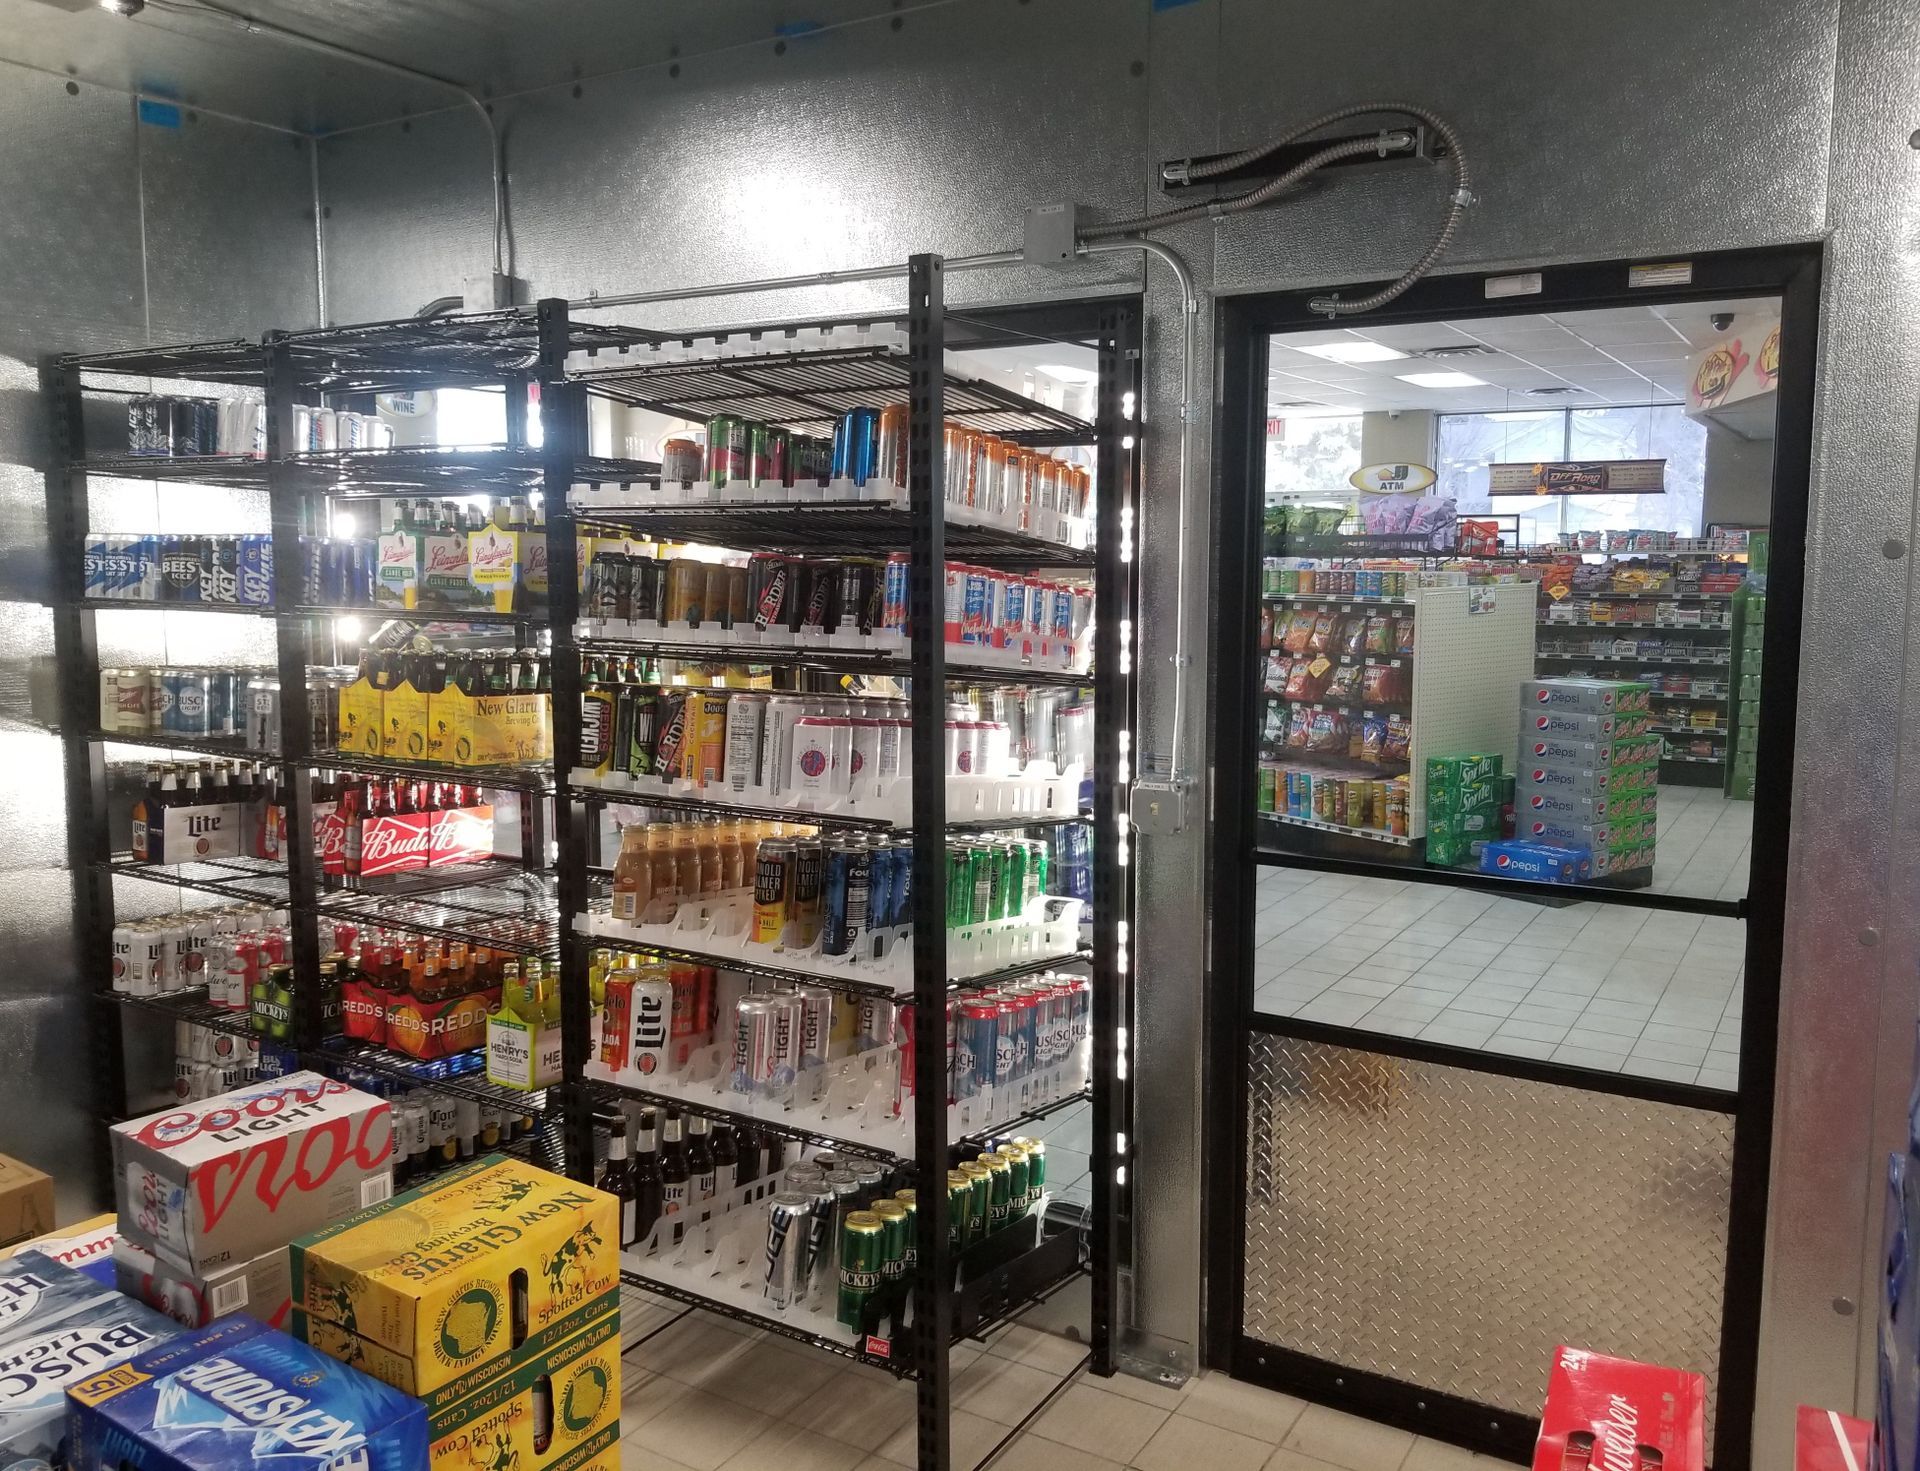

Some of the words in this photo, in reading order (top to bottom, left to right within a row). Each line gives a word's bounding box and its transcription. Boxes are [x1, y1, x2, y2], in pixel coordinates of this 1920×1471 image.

[393, 400, 415, 414] WINE
[1266, 419, 1281, 435] XIT
[1380, 482, 1404, 490] ATM
[477, 699, 503, 716] New
[1551, 694, 1580, 705] pepsi
[505, 715, 531, 726] Brewing
[580, 701, 601, 753] WICKED
[1550, 721, 1579, 732] pepsi
[1547, 748, 1577, 759] pepsi
[1547, 774, 1575, 785] pepsi
[1462, 784, 1490, 812] Sprite
[1545, 800, 1574, 811] pepsi
[133, 822, 146, 833] Lite
[184, 815, 221, 837] Lite
[1510, 859, 1540, 873] pepsi
[342, 1000, 383, 1018] REDD'S
[387, 1012, 430, 1033] REDD'S
[635, 996, 667, 1050] Lite
[805, 1008, 819, 1050] LIGHT
[736, 1022, 750, 1067] LIGHT
[776, 1016, 790, 1060] LIGHT
[490, 1042, 529, 1060] HENRY'S
[124, 1078, 353, 1149] Coors
[210, 1101, 333, 1143] LIGHT
[156, 1178, 171, 1241] LIGHT
[524, 1190, 597, 1227] New
[415, 1217, 497, 1252] Brewing
[220, 1250, 231, 1262] 12
[401, 1227, 523, 1282] Glarus
[447, 1282, 474, 1308] Glarus
[538, 1287, 583, 1325] Spotted
[585, 1273, 612, 1295] Cow
[541, 1316, 583, 1345] 12/12oz.
[584, 1300, 609, 1320] Cans
[595, 1323, 612, 1342] ONLY
[195, 1333, 224, 1347] MORE
[868, 1340, 889, 1354] Coca-Cola
[145, 1348, 190, 1369] STONES
[433, 1340, 452, 1368] DRINK
[546, 1338, 587, 1371] WISCONSIN
[78, 1379, 120, 1398] 15
[436, 1385, 456, 1405] ONLY
[466, 1354, 512, 1388] WISCONSIN
[472, 1378, 517, 1411] 12/12oz.
[174, 1357, 367, 1455] KEYSTONE
[436, 1408, 469, 1431] Cans
[471, 1401, 523, 1442] Spotted
[434, 1434, 469, 1460] Cow
[593, 1430, 612, 1449] ONLY
